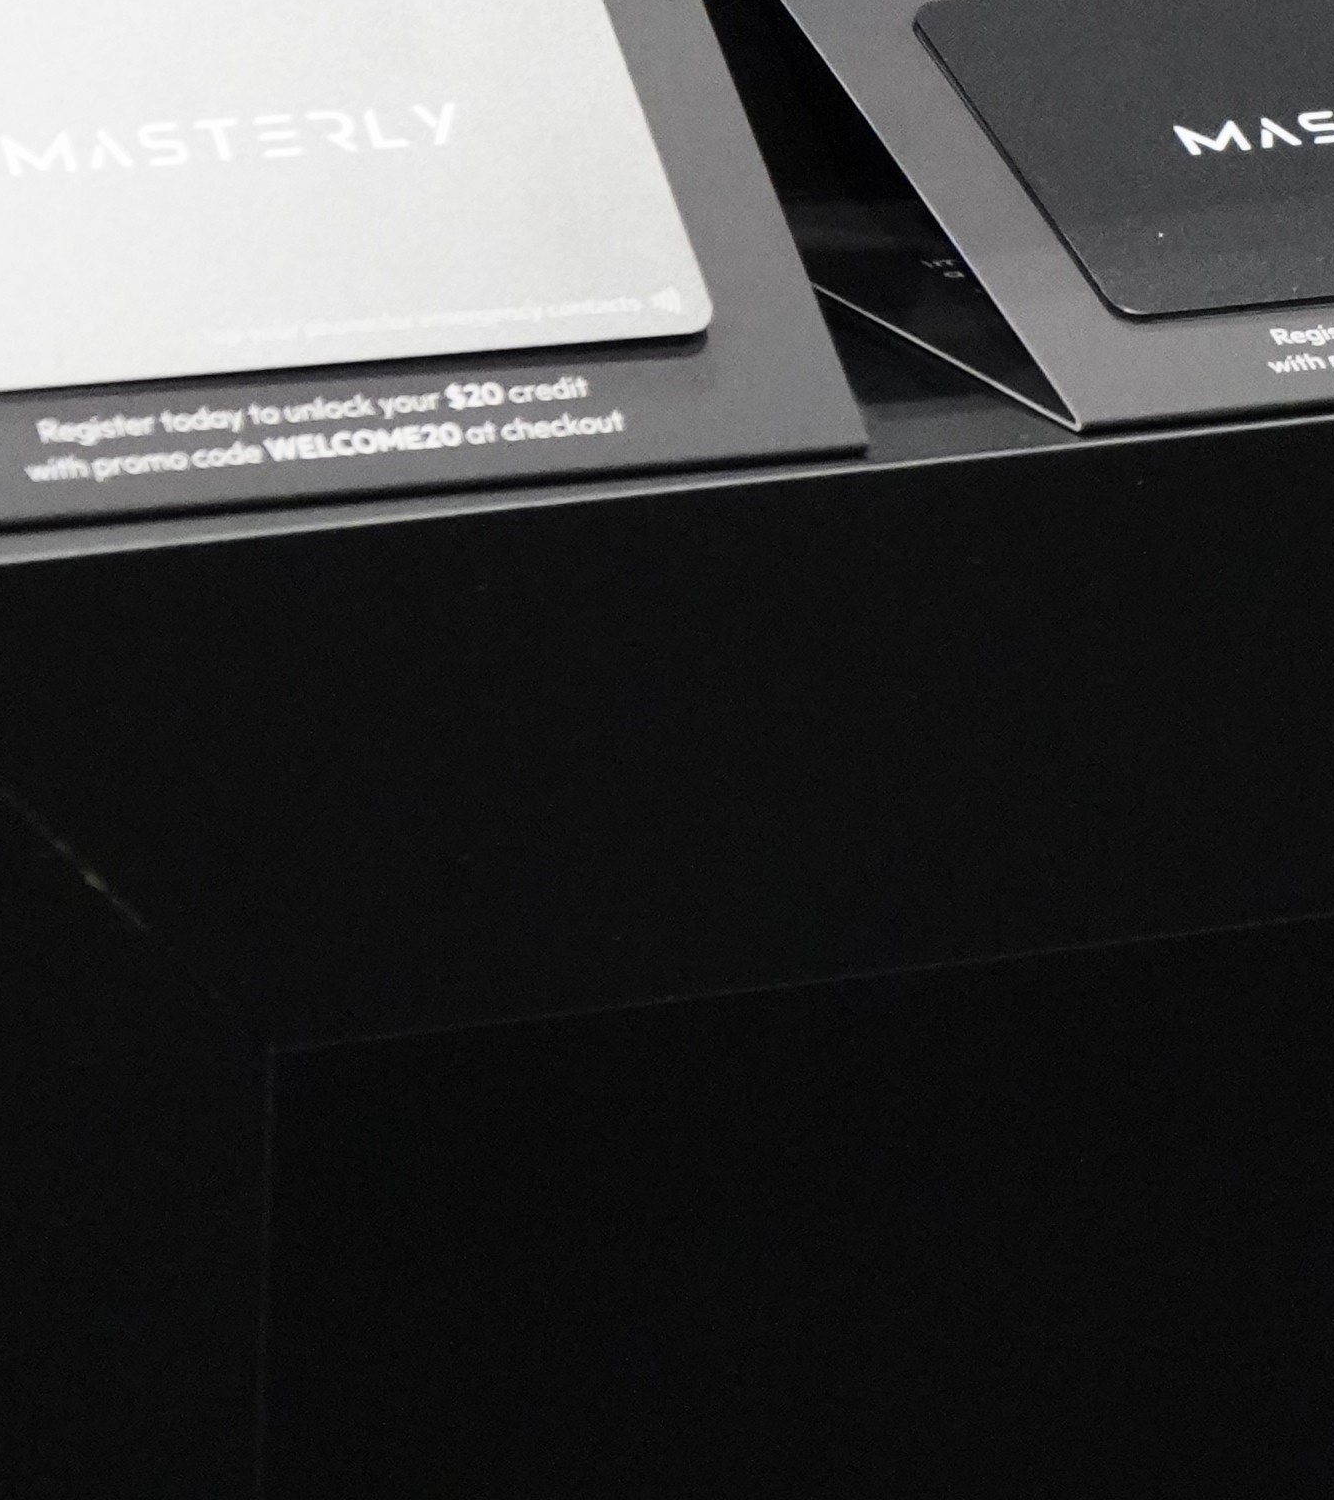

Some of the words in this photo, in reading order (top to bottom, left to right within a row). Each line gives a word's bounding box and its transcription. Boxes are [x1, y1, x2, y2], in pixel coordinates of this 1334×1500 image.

[0, 102, 458, 179] MASTERLY
[1268, 353, 1326, 373] with
[25, 455, 92, 481] with
[91, 451, 190, 482] promo
[187, 441, 263, 468] code
[263, 422, 464, 461] WELCOME20
[464, 421, 496, 444] at
[501, 410, 624, 441] checkout
[37, 415, 155, 446] Register
[159, 407, 244, 432] today
[247, 404, 281, 425] to
[278, 394, 376, 423] unlock
[378, 393, 440, 419] your
[445, 382, 505, 410] $20
[508, 377, 588, 403] credit
